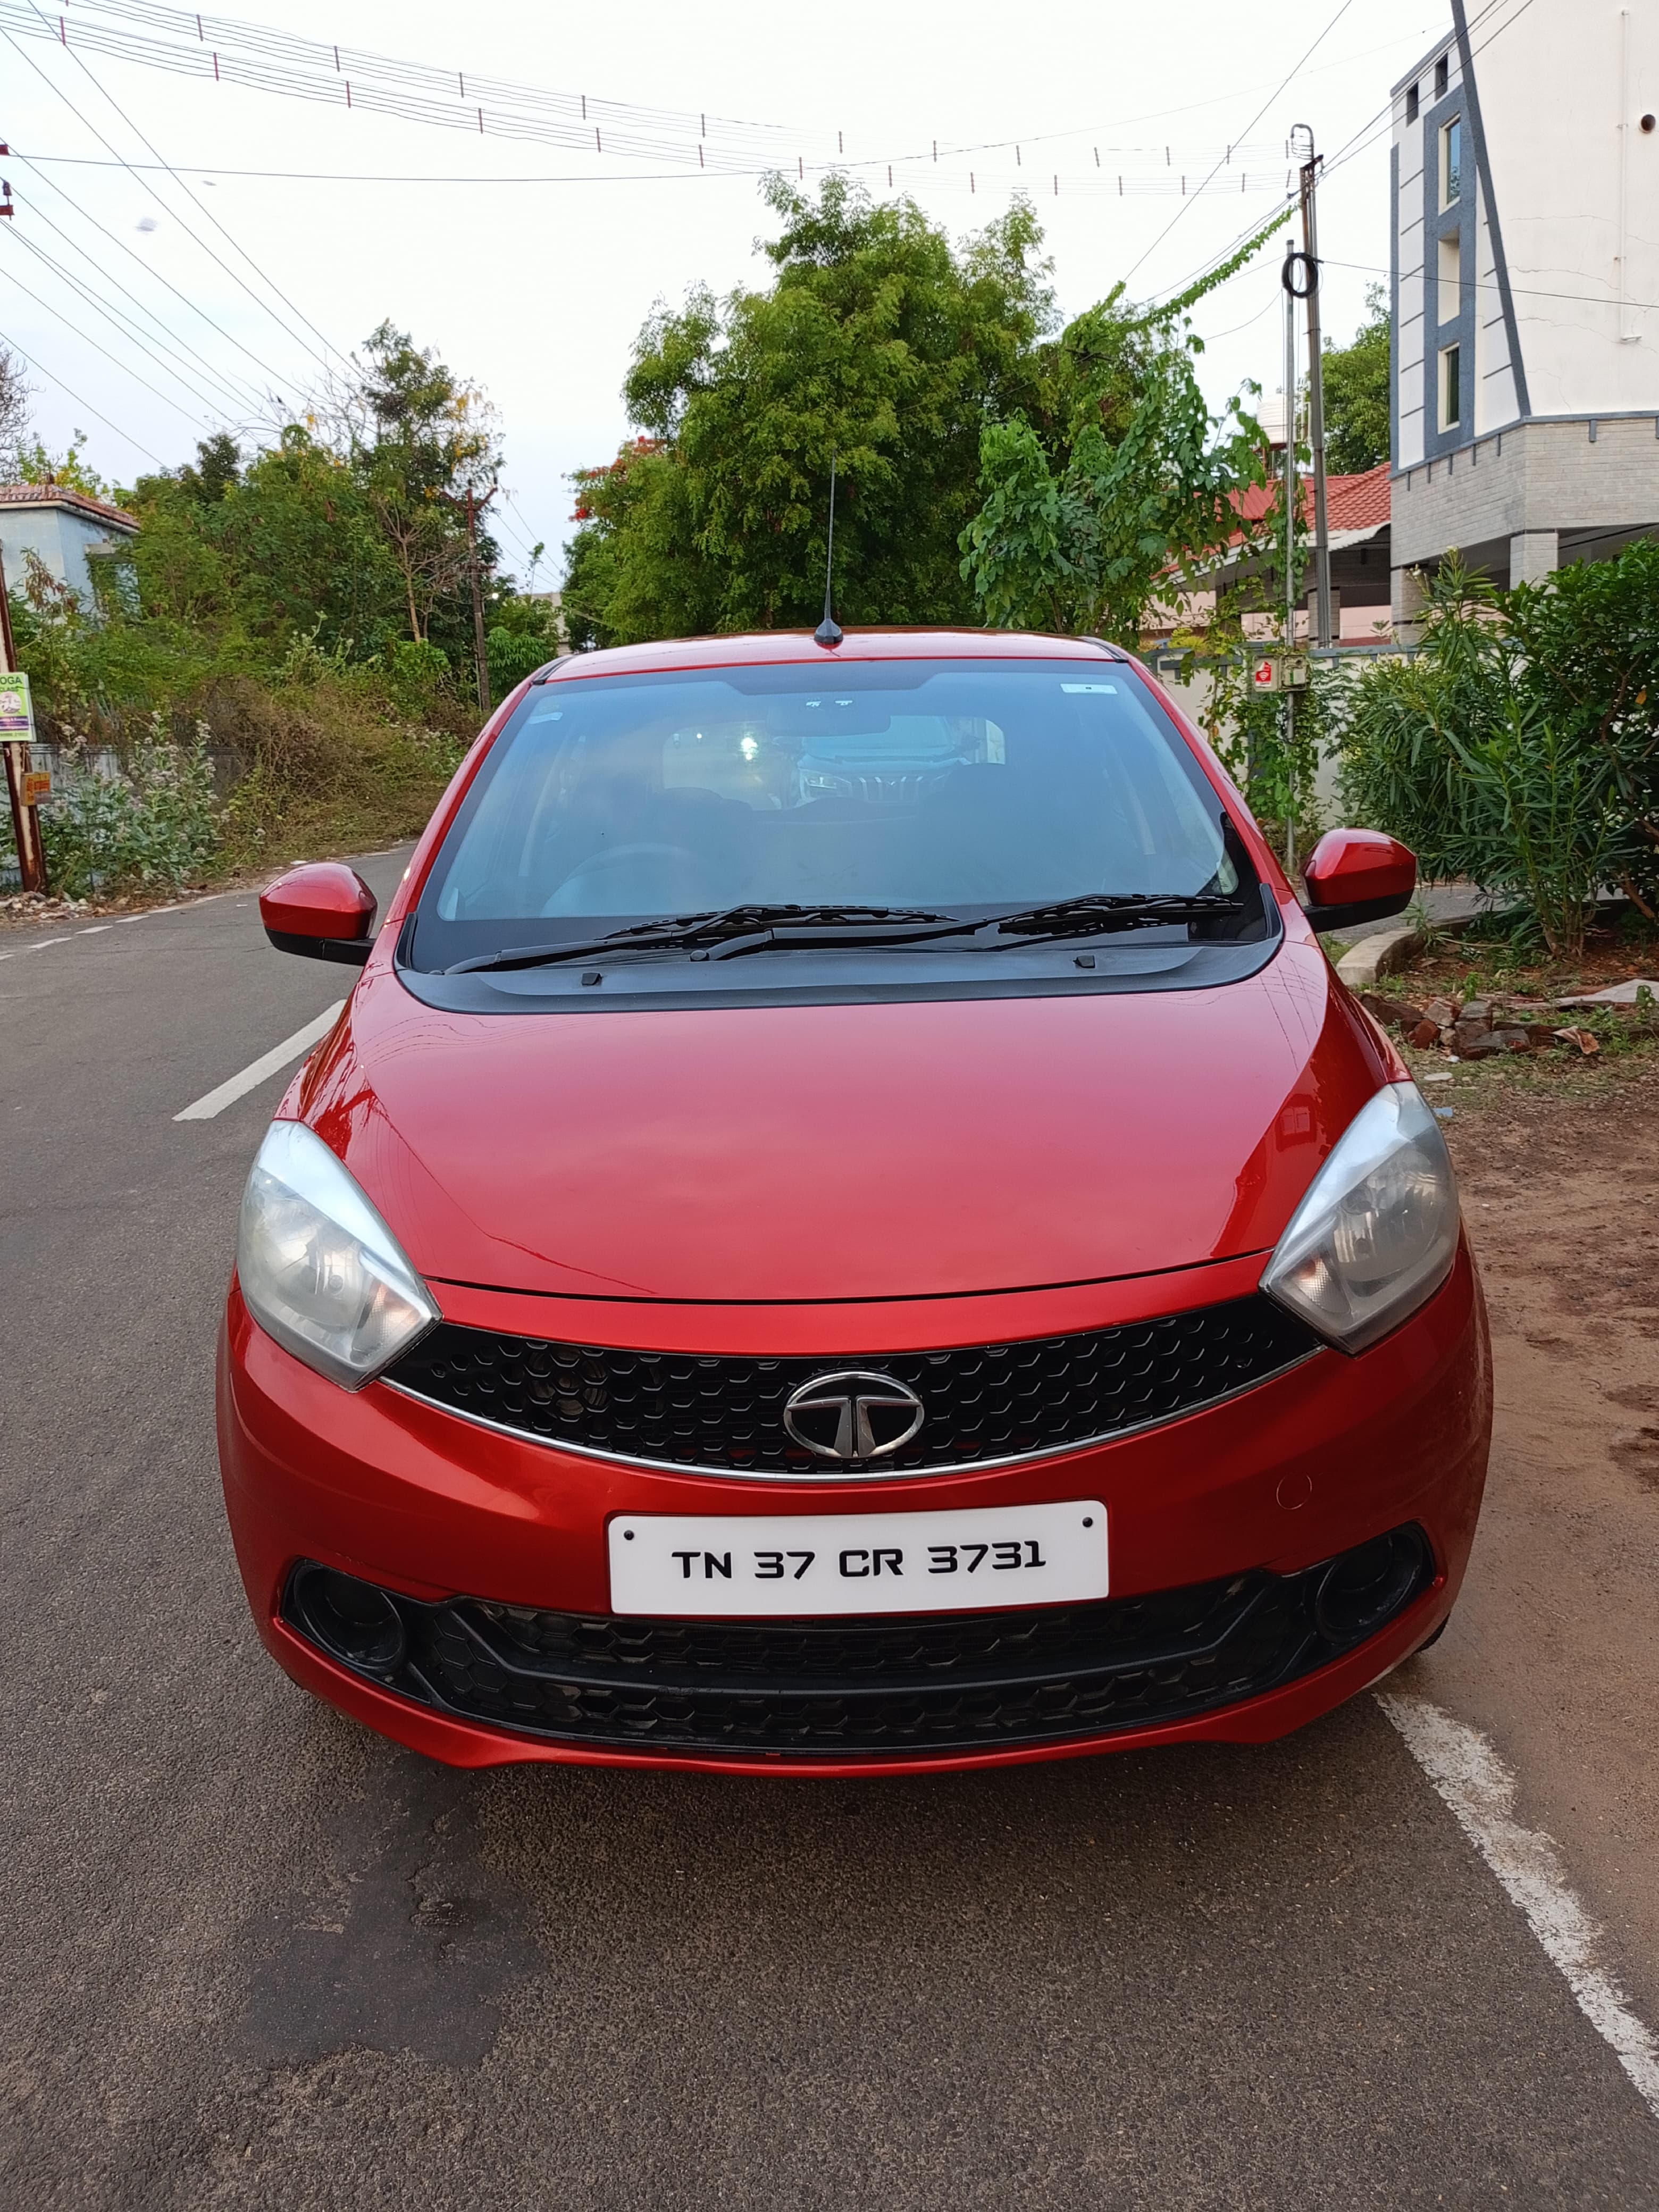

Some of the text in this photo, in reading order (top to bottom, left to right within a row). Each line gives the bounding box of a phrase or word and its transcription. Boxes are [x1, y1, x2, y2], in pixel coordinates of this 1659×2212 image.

[672, 1540, 1046, 1580] TN 37 CR 3731
